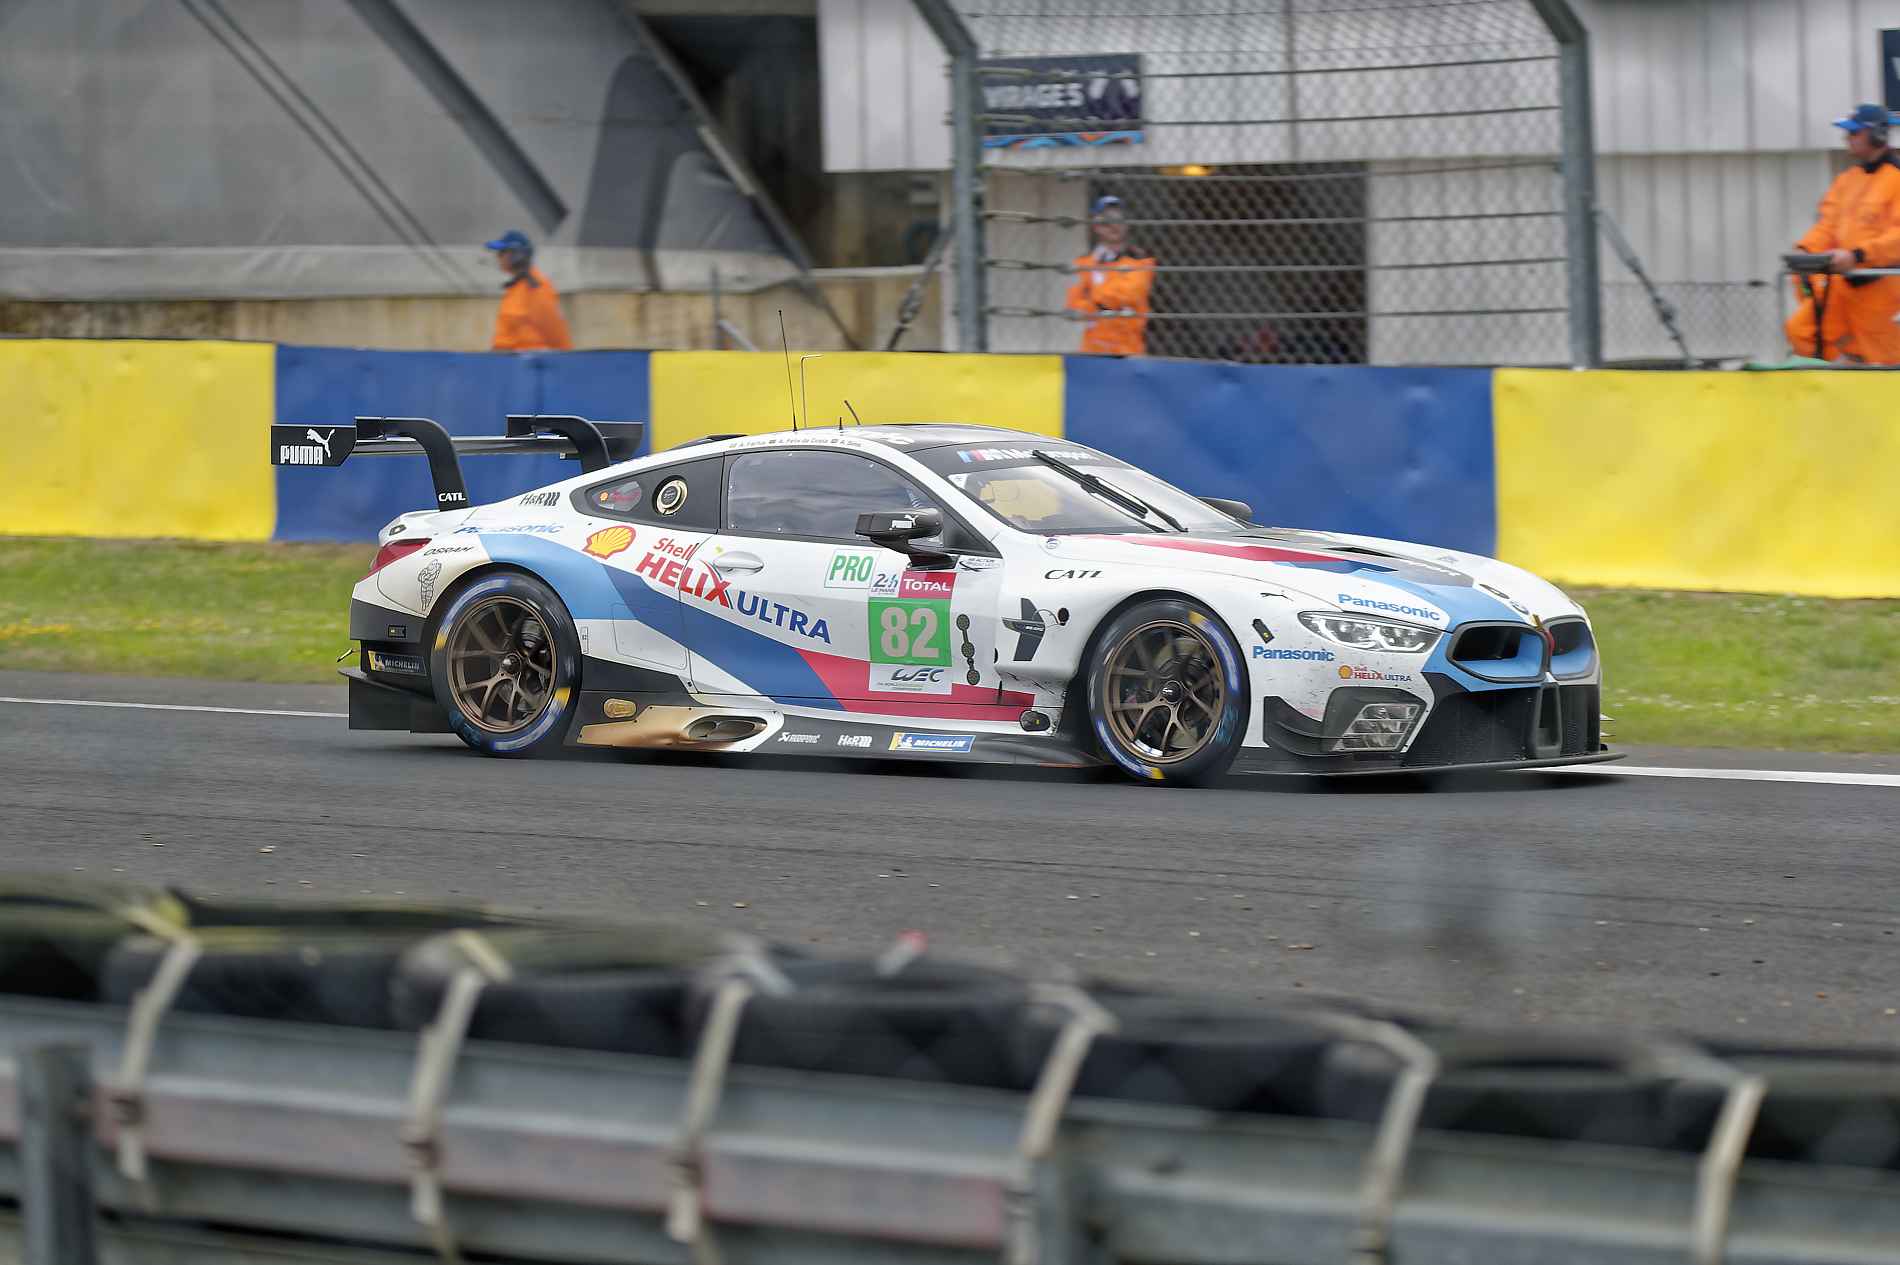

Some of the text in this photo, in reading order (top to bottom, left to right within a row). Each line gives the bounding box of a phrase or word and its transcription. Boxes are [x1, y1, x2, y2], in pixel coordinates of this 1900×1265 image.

[280, 445, 323, 464] PUMA
[438, 492, 466, 502] CATL
[452, 524, 564, 535] Pasonic
[653, 537, 699, 561] Shell
[829, 555, 873, 582] PRO
[1045, 570, 1103, 579] CATL
[904, 578, 951, 592] TOTAL
[635, 552, 832, 644] HELIX ULTRA
[1338, 594, 1440, 621] Panasonic
[881, 606, 939, 658] 82
[1252, 646, 1335, 661] Panasonic
[385, 658, 420, 670] MICHELIN
[891, 668, 944, 682] WEC
[914, 739, 966, 748] MICHELIN
